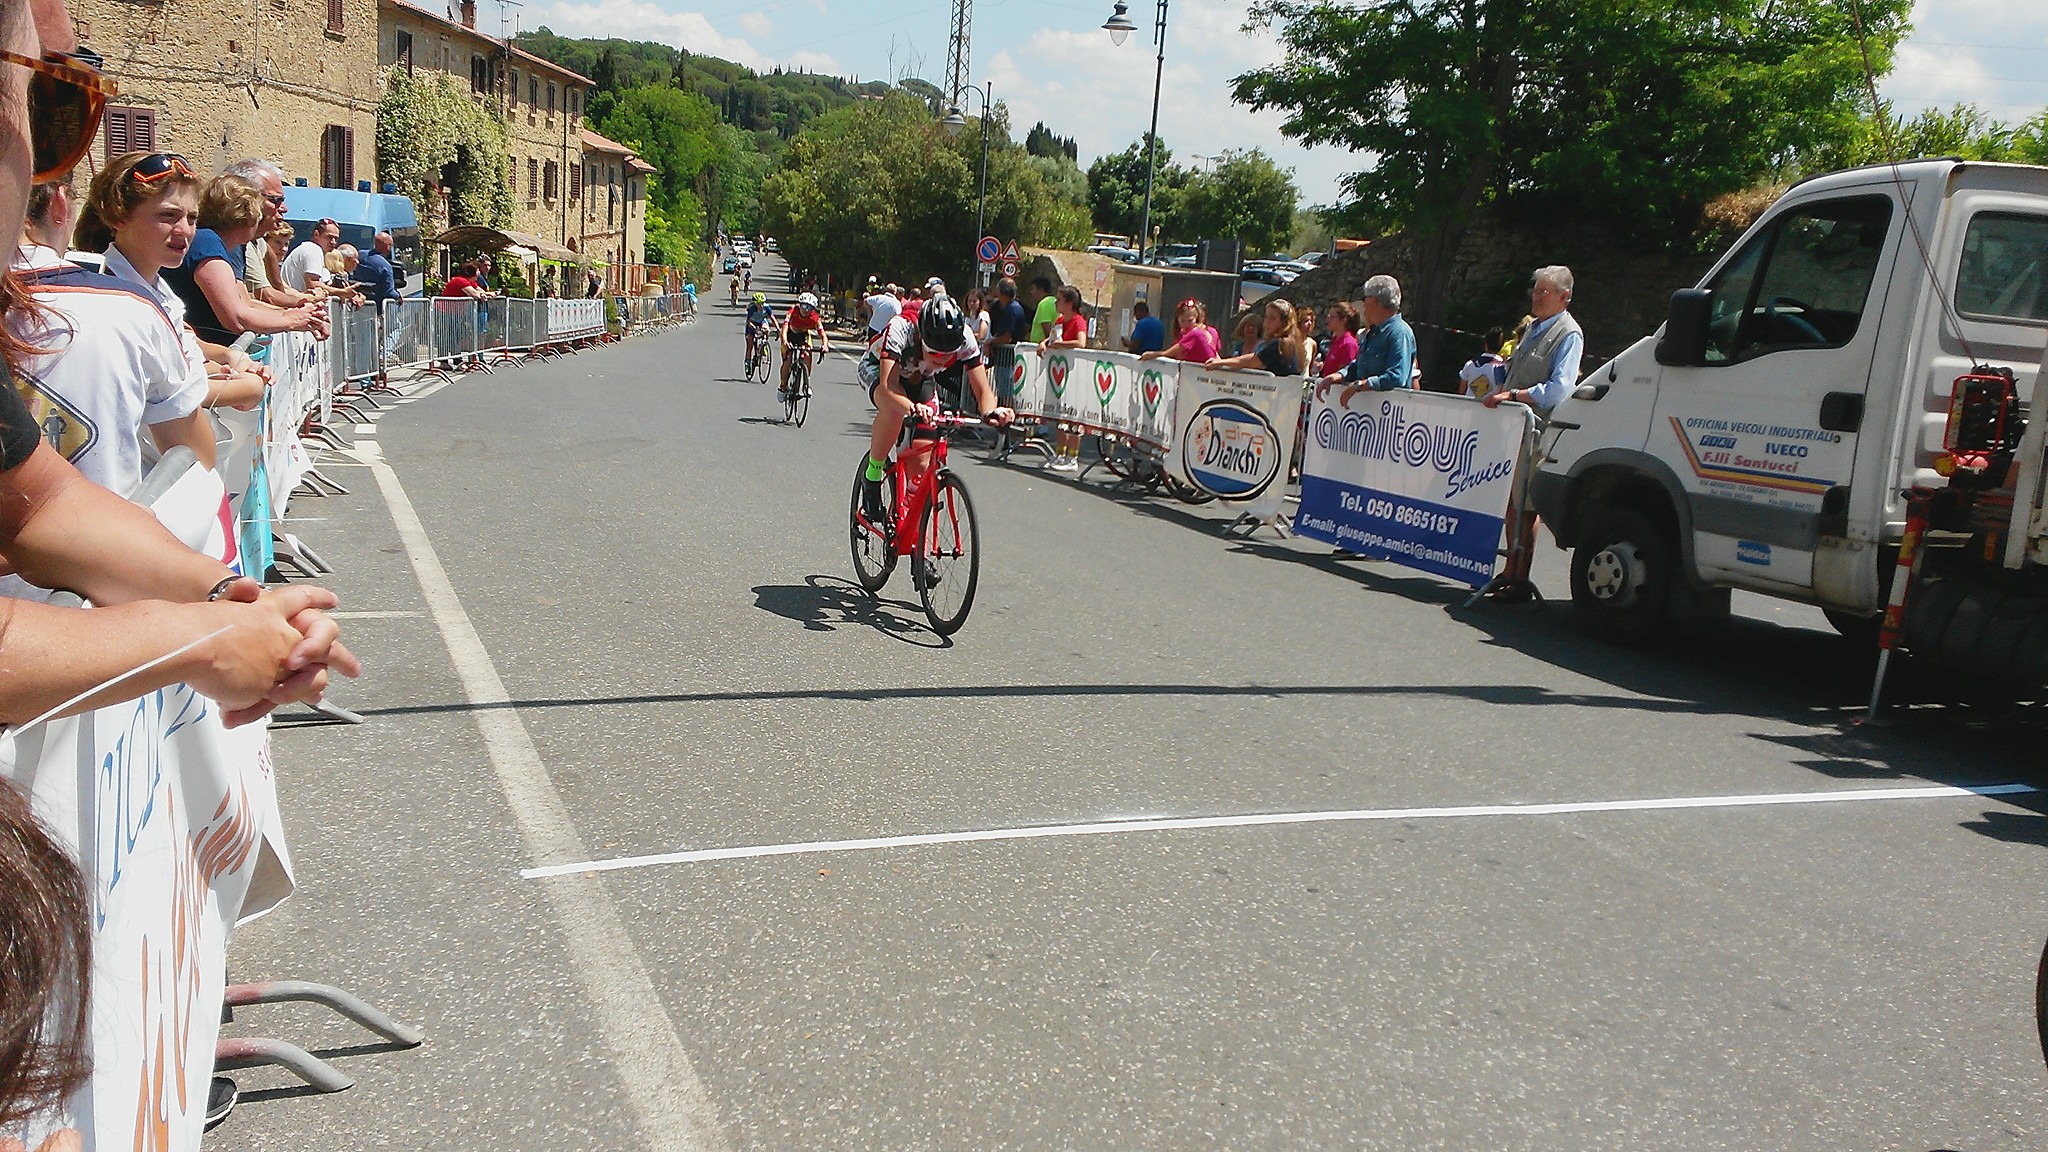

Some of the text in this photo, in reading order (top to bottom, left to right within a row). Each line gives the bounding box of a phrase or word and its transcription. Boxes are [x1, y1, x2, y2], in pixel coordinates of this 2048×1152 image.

[1005, 265, 1014, 274] 40
[1225, 425, 1264, 445] dino
[1686, 417, 1834, 442] OFFICINA VEICOLI INDUSTRIALI
[1700, 435, 1737, 449] FIAT
[1765, 442, 1808, 457] IVECO
[1733, 455, 1799, 474] Santucci
[1445, 459, 1512, 498] Service
[1302, 513, 1336, 533] E-mail:
[1341, 491, 1459, 536] Tel. 050 8665187
